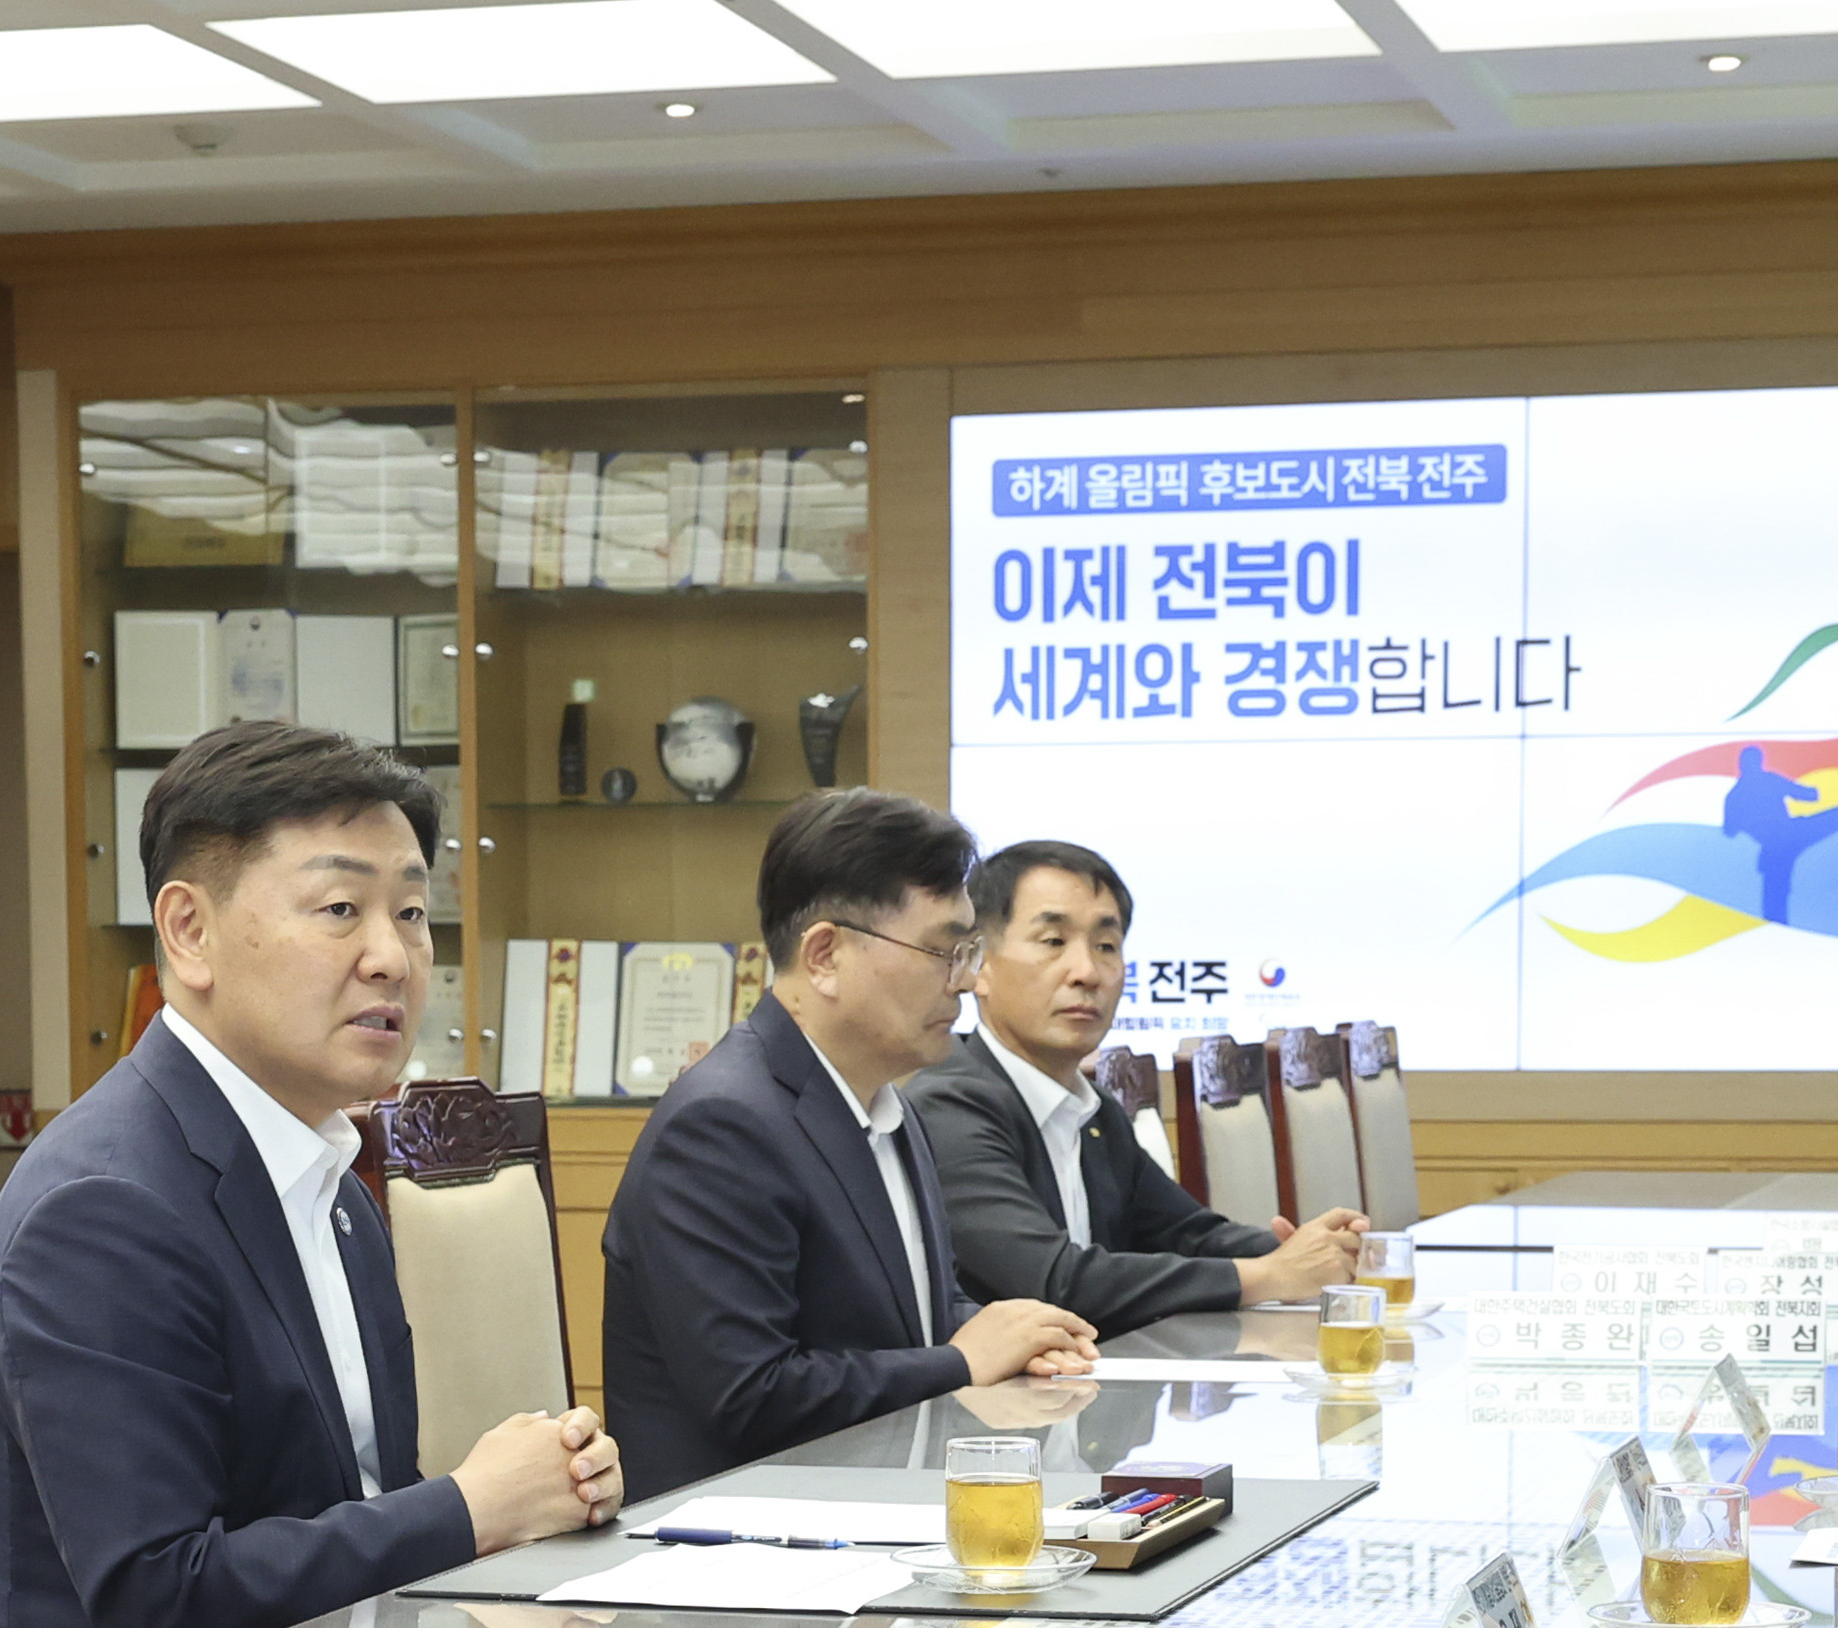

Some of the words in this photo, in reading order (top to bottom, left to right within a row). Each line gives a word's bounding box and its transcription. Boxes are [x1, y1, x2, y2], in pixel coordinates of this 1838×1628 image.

[1008, 464, 1079, 511] 하계
[1085, 459, 1190, 509] 올림픽
[1198, 455, 1336, 506] 후보도시
[1341, 453, 1413, 501] 전북
[1416, 452, 1489, 500] 전주
[992, 543, 1128, 623] 이제
[1151, 538, 1362, 621] 전북이
[991, 640, 1200, 722] 세계와
[1221, 634, 1582, 719] 경쟁합니다
[1149, 961, 1229, 1004] 전주
[1593, 1271, 1698, 1296] 이재수
[1473, 1298, 1577, 1316] 대한주택건설협회
[1584, 1299, 1636, 1316] 전북도회
[1775, 1300, 1822, 1318] 전북지회
[1515, 1322, 1635, 1352] 박종완
[1698, 1323, 1818, 1353] 송일섭
